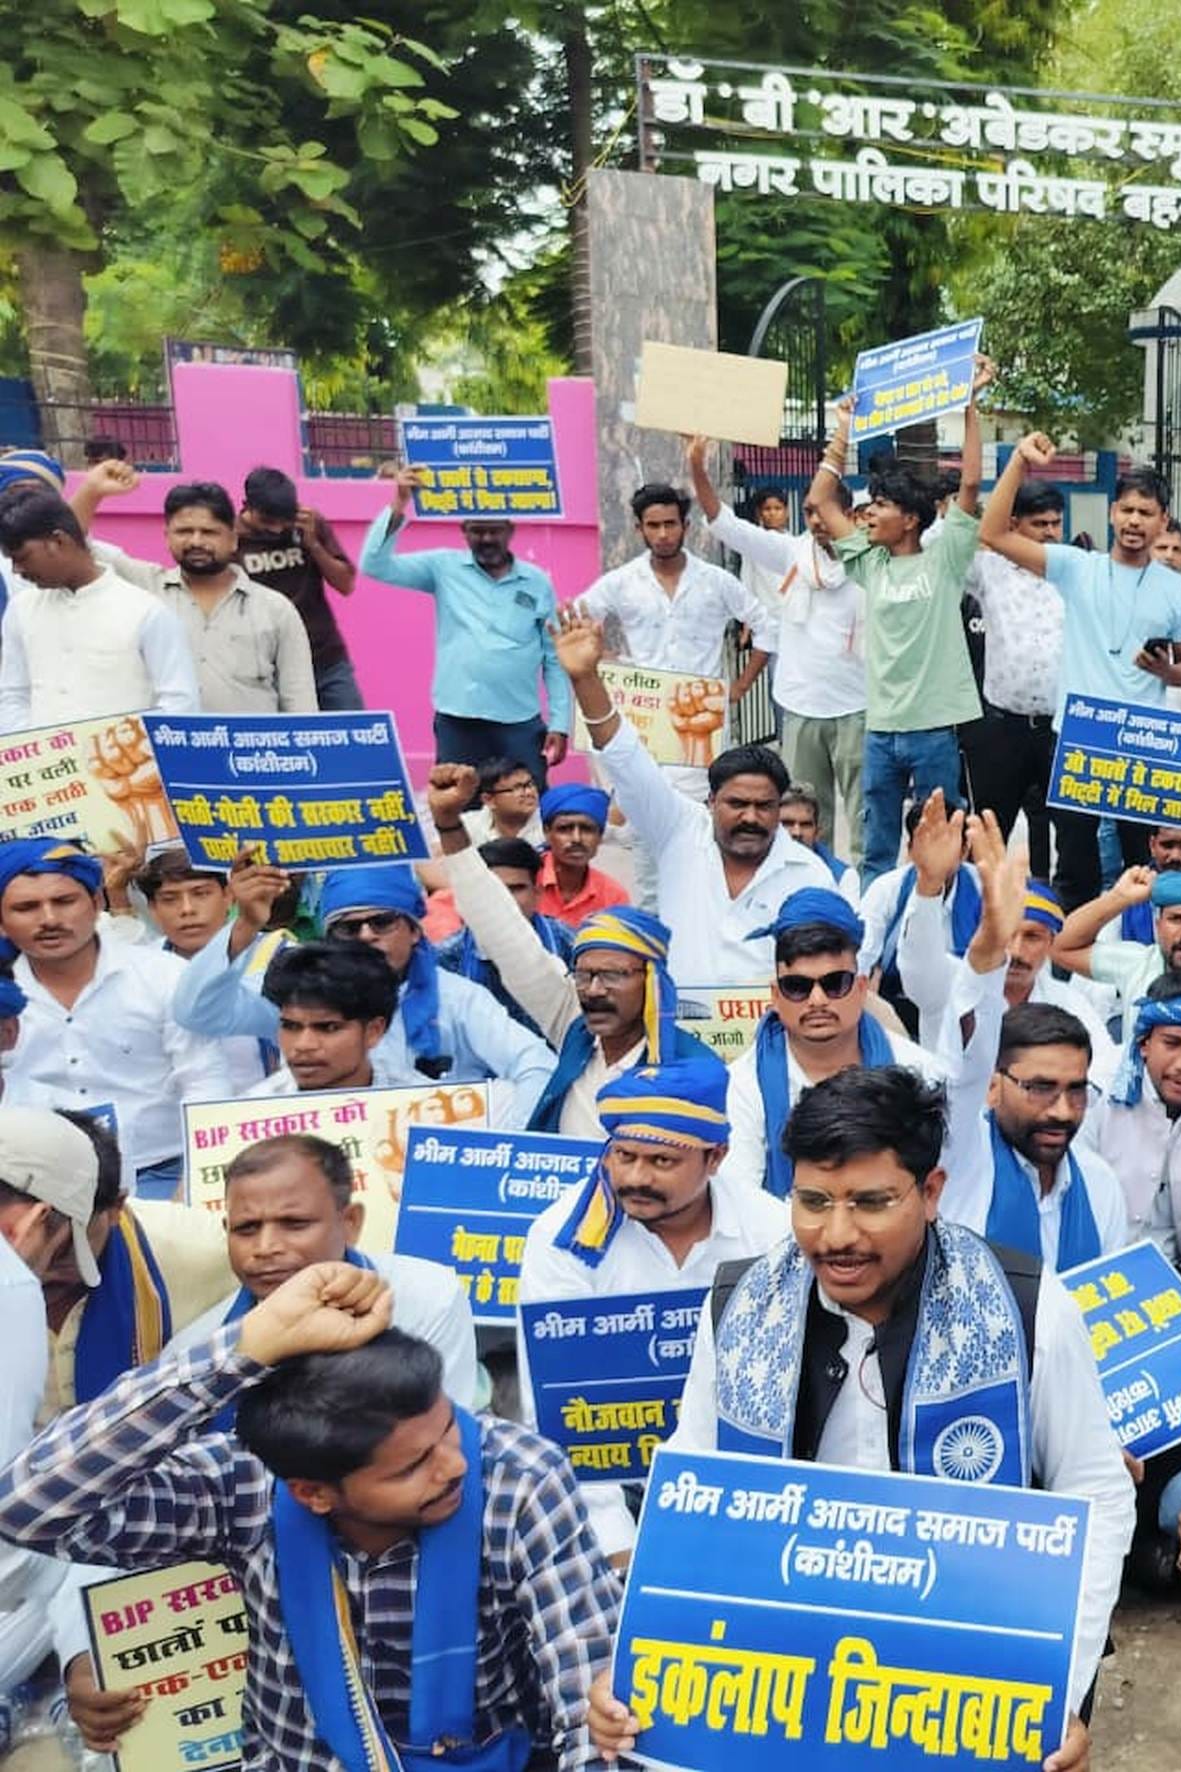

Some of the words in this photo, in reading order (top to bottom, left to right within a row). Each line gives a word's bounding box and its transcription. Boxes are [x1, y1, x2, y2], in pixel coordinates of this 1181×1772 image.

[694, 151, 800, 196] नगर
[810, 147, 966, 206] पालिका
[244, 547, 304, 574] DIOR
[46, 730, 77, 750] को
[353, 723, 389, 745] पार्टी
[7, 772, 32, 788] पर
[42, 780, 88, 806] लाठी
[194, 1125, 230, 1149] BJP
[235, 1111, 320, 1142] सरकार
[329, 1097, 368, 1124] को
[414, 1136, 457, 1164] भीम
[460, 1143, 513, 1168] आर्मी
[514, 1152, 582, 1173] आजाद
[533, 1311, 585, 1339] भीम
[593, 1303, 656, 1335] आर्मी
[561, 1397, 665, 1433] नौजवान
[567, 1440, 631, 1469] न्याय
[658, 1471, 723, 1517] भीम
[725, 1483, 807, 1527] आर्मी
[807, 1497, 909, 1538] आजाद
[915, 1509, 1009, 1549] समाज
[1016, 1515, 1079, 1558] पार्टी
[780, 1533, 938, 1600] (कांशीराम)
[101, 1599, 155, 1637] BJP
[173, 1696, 226, 1727] का
[824, 1635, 1054, 1763] जिन्दाबाद
